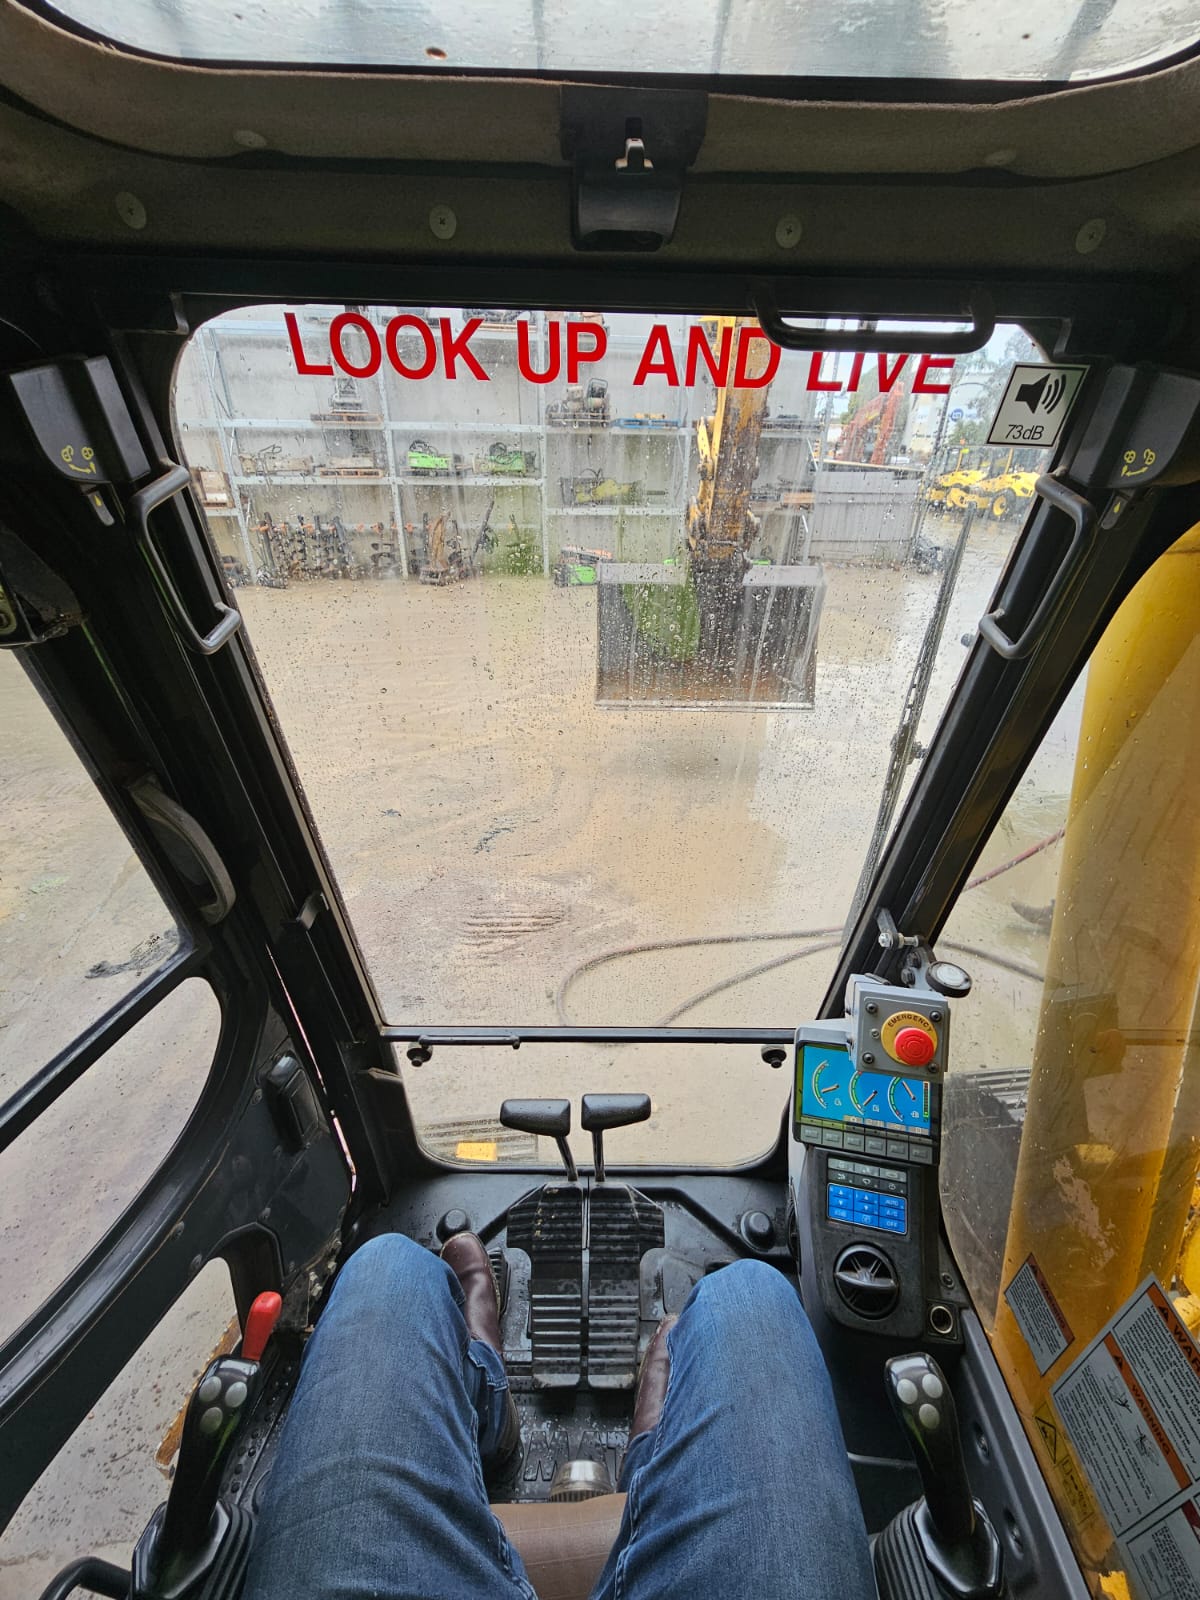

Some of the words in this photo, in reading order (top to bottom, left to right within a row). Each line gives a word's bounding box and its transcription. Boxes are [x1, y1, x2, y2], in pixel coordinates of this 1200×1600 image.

[284, 312, 491, 381] LOOK
[516, 320, 608, 384] UP
[633, 324, 782, 388] AND
[806, 352, 956, 394] LIVE
[1005, 424, 1045, 440] 73dB
[887, 1014, 932, 1032] EMERGENCY
[1132, 1384, 1171, 1455] WARNING
